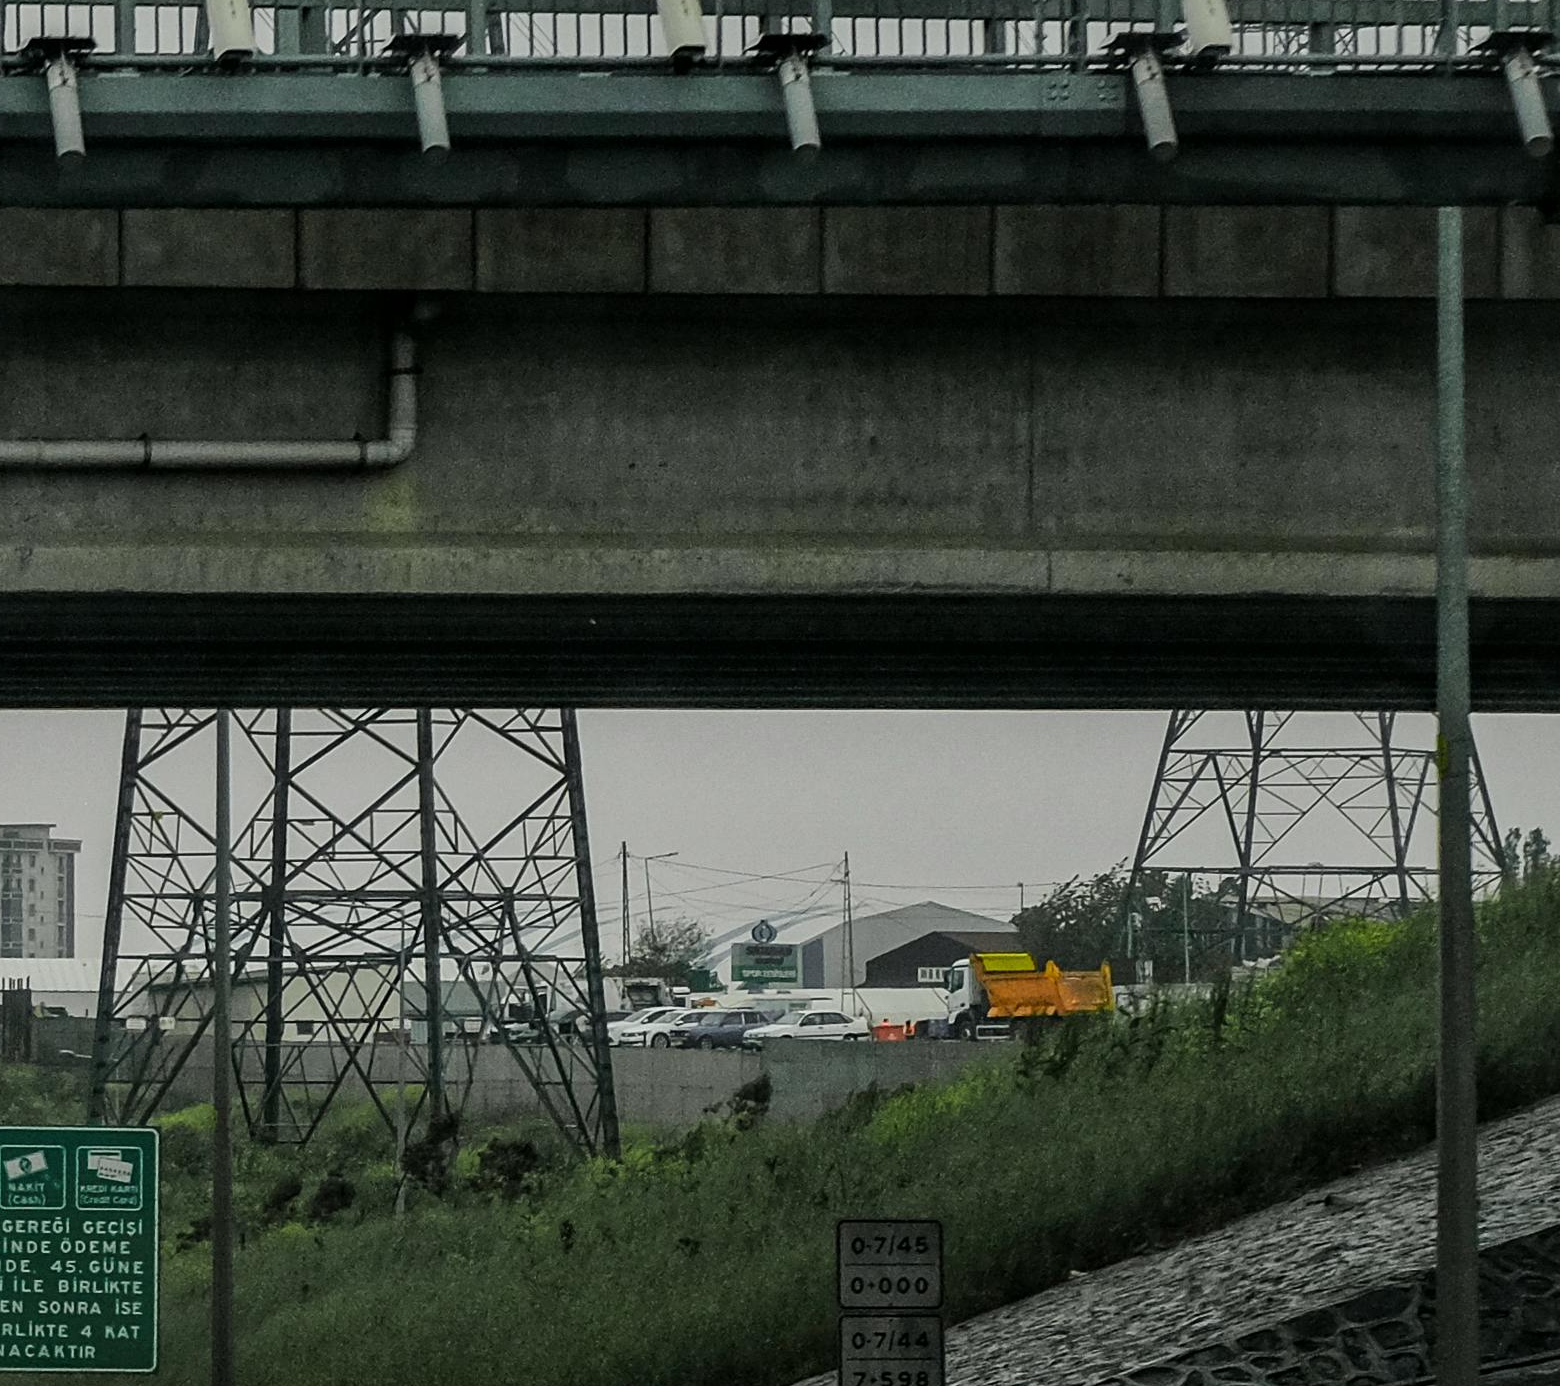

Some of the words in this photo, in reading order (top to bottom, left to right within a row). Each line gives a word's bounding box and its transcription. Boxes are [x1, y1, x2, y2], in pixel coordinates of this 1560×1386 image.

[9, 1195, 45, 1205] (Cash)
[3, 1217, 69, 1233] GEREĞİ
[83, 1220, 142, 1236] GEÇİŞİ
[61, 1238, 130, 1254] ÖDEME
[90, 1261, 143, 1274] GÜNE
[14, 1276, 43, 1292] İLE
[59, 1280, 142, 1294] BİRLİKTE
[39, 1301, 101, 1314] SONRA
[116, 1299, 142, 1314] İSE
[81, 1326, 91, 1337] 4
[106, 1326, 139, 1338] KAT
